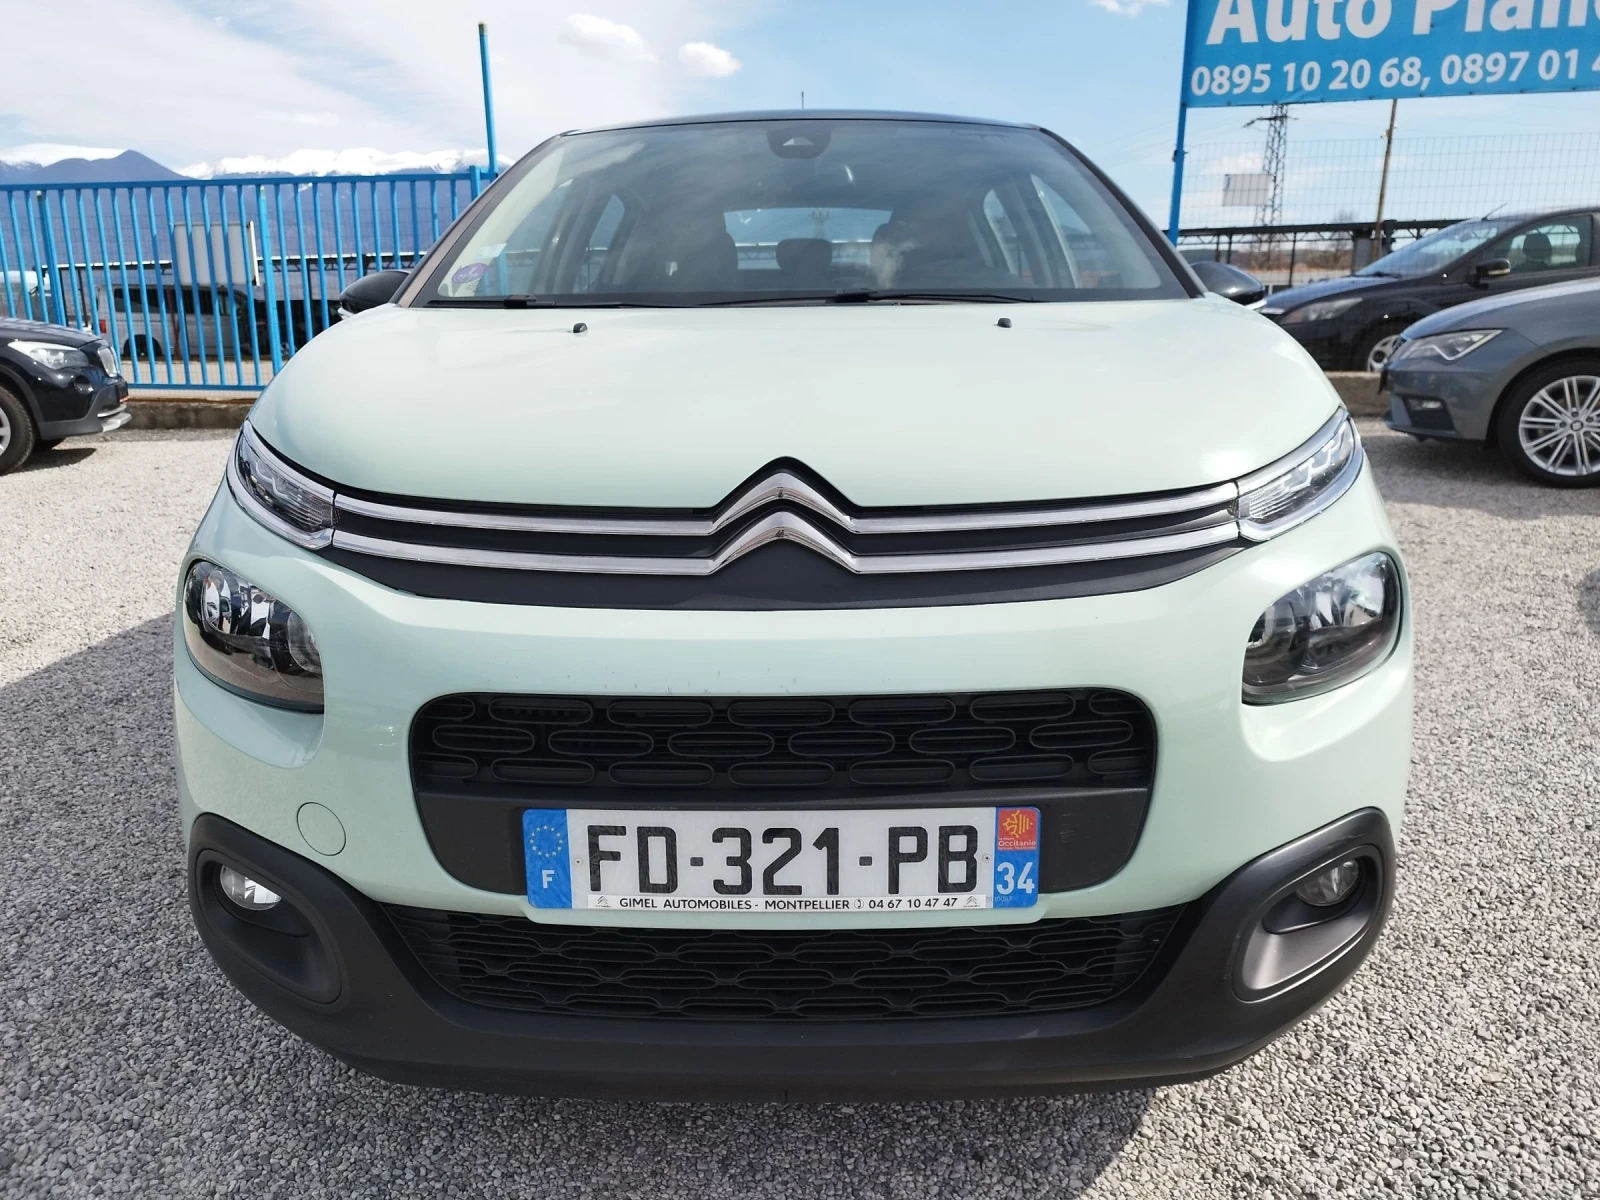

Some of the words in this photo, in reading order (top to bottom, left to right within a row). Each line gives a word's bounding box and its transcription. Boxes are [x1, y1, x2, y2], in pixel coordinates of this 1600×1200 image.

[1206, 0, 1392, 45] Auto
[1191, 63, 1271, 96] 0895
[1283, 62, 1321, 92] 10
[1328, 59, 1371, 90] 20
[1379, 56, 1431, 90] 68,
[1440, 51, 1530, 84] 0897
[1538, 49, 1580, 80] 01
[541, 869, 555, 889] F
[587, 825, 978, 895] FD-321-PB
[996, 861, 1035, 895] 34
[619, 898, 657, 908] GIMEL
[765, 900, 850, 910] MONTPELLIER
[869, 900, 884, 909] 04
[887, 899, 901, 909] 67
[907, 899, 921, 909] 10
[924, 898, 939, 908] 47
[943, 898, 958, 907] 47
